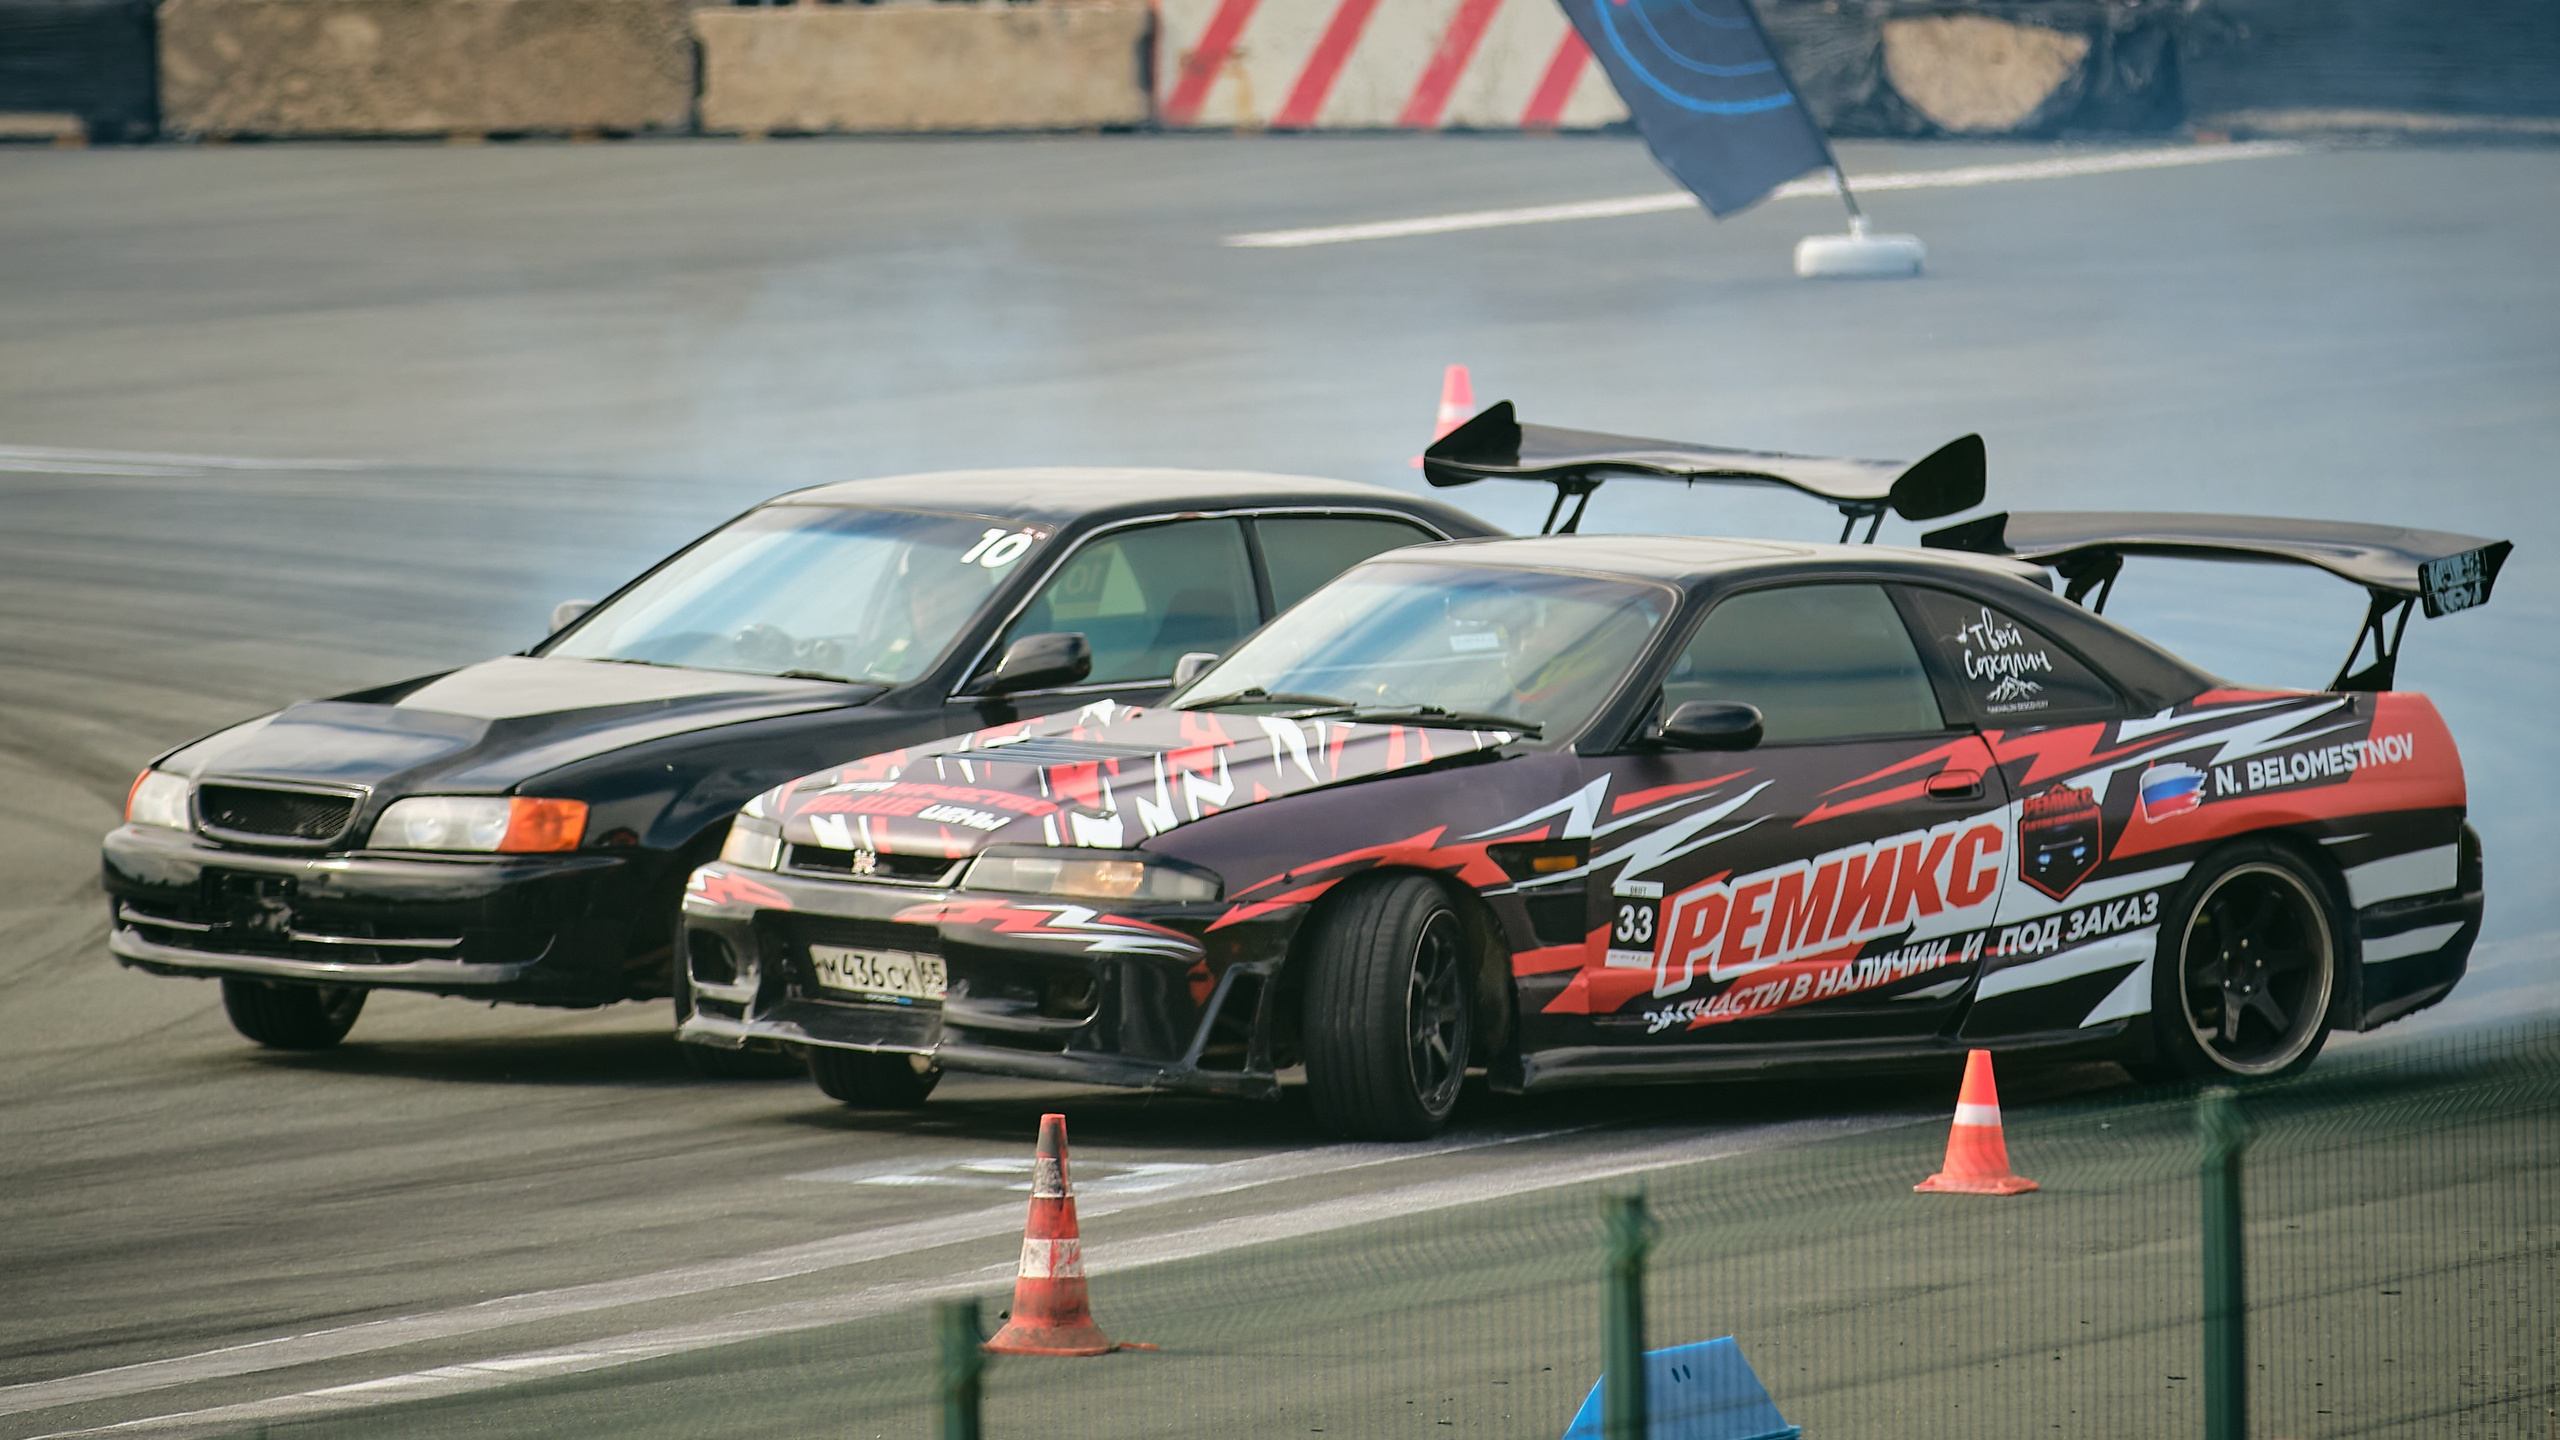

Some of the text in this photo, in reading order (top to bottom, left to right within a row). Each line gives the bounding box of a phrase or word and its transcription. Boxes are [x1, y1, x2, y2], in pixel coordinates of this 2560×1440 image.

[960, 527, 1033, 569] 10
[1968, 606, 2023, 652] Твой
[1964, 648, 2053, 682] Сахалин
[2214, 732, 2414, 797] N. BELOMESTNOV
[917, 803, 1012, 832] ЦЕНЫ
[1616, 904, 1654, 944] 33
[1655, 821, 2004, 996] РЕМИКС
[1642, 892, 2161, 1034] ЗАПЧАСТИ В НАЛИЧИИ И ПОД ЗАКАЗ
